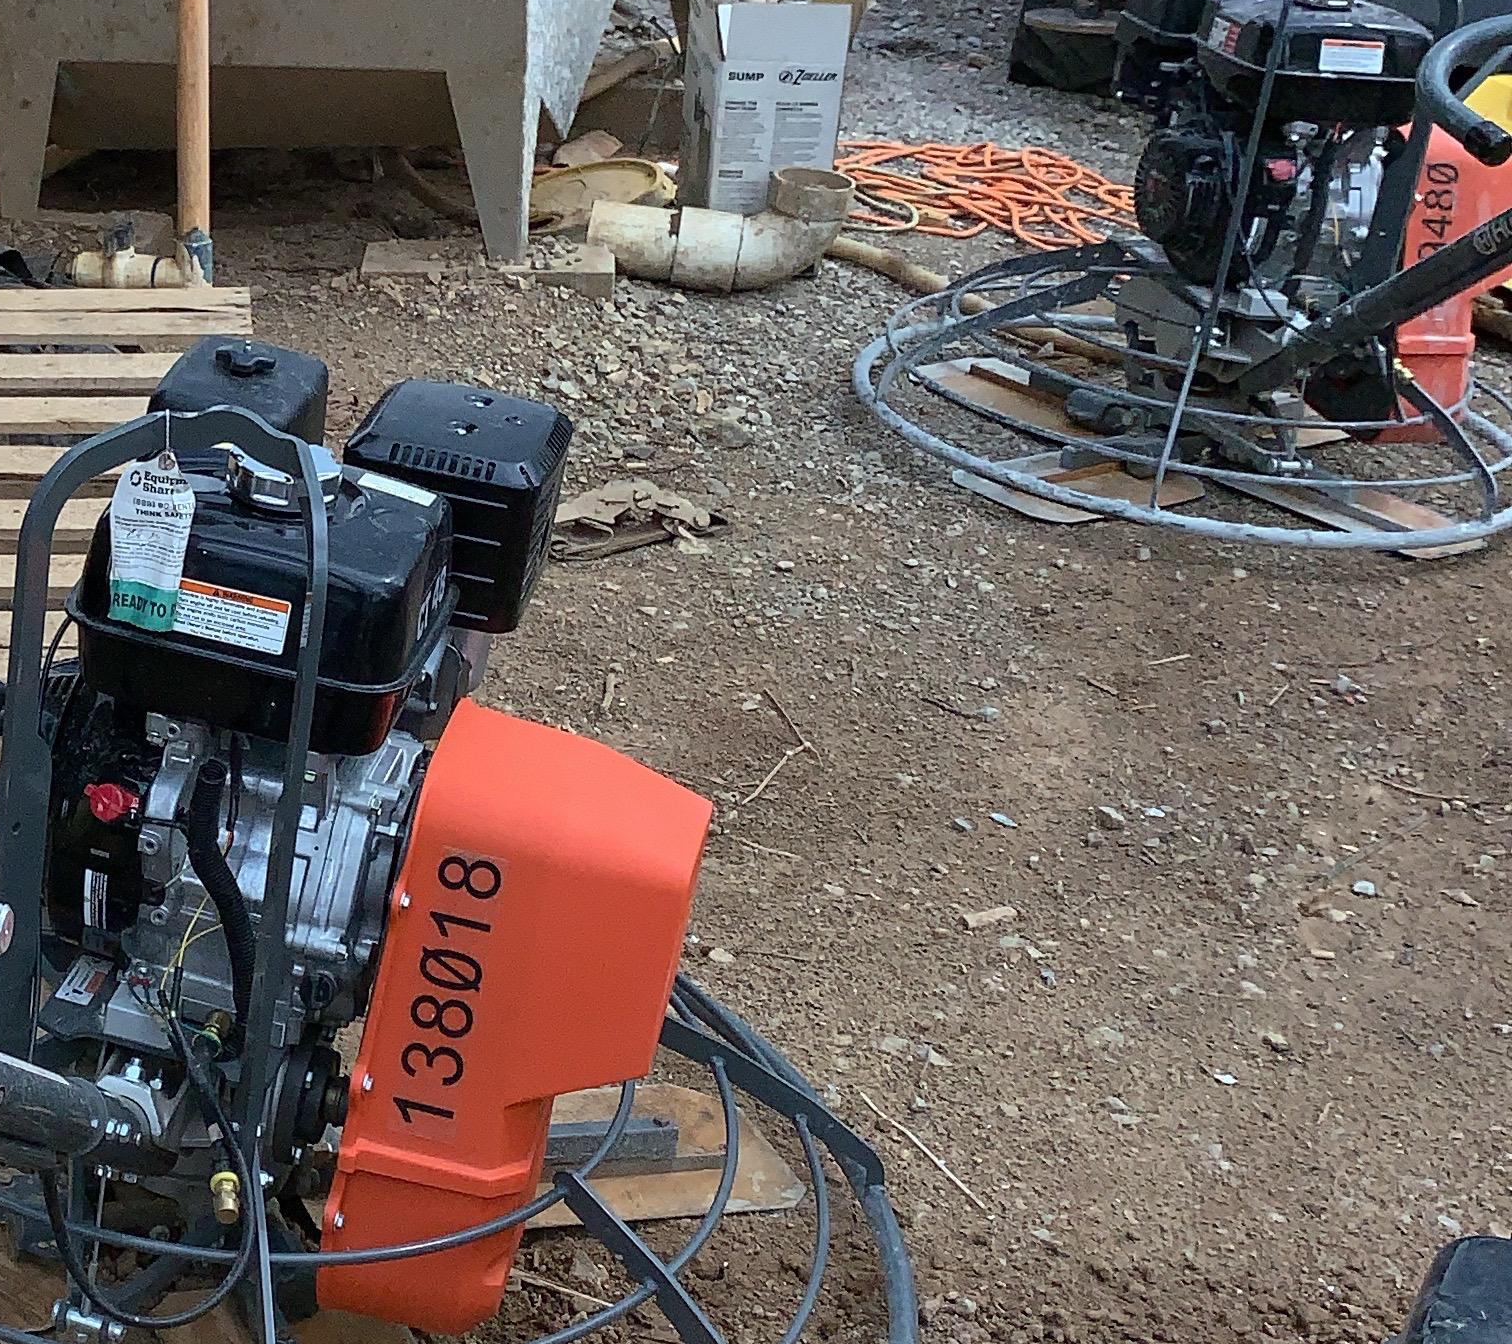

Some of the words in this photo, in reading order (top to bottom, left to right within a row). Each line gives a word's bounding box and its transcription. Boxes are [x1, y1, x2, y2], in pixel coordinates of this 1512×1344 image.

[728, 71, 765, 82] SUMP
[136, 508, 163, 518] THINK
[112, 593, 150, 612] READY
[149, 602, 167, 618] TO
[392, 855, 502, 1124] 138018
